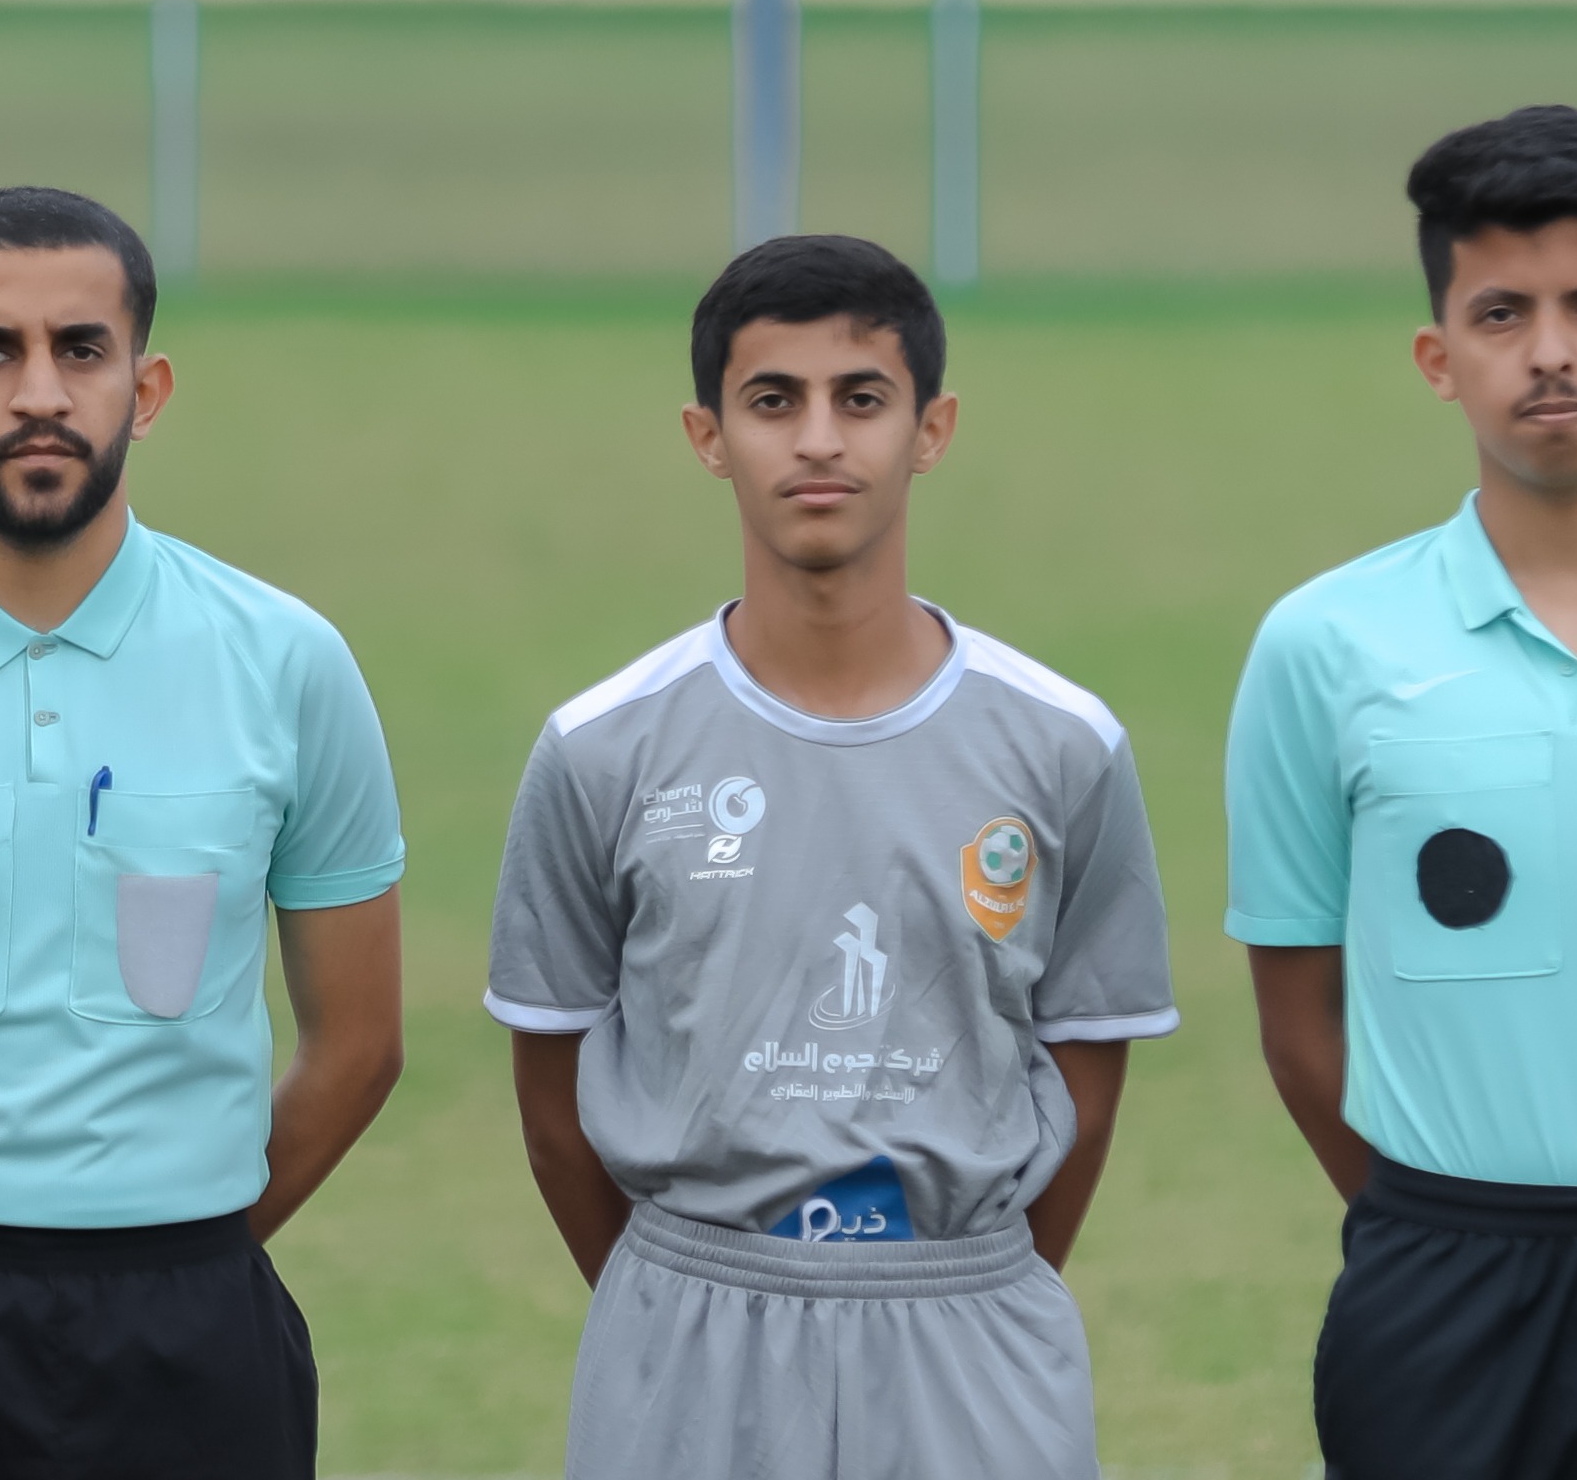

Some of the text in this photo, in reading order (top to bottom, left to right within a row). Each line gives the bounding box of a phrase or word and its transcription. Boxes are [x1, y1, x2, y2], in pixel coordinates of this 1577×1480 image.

[689, 866, 755, 881] HATTRICK
[744, 1041, 819, 1073] السلام
[770, 1083, 819, 1101] العقاري
